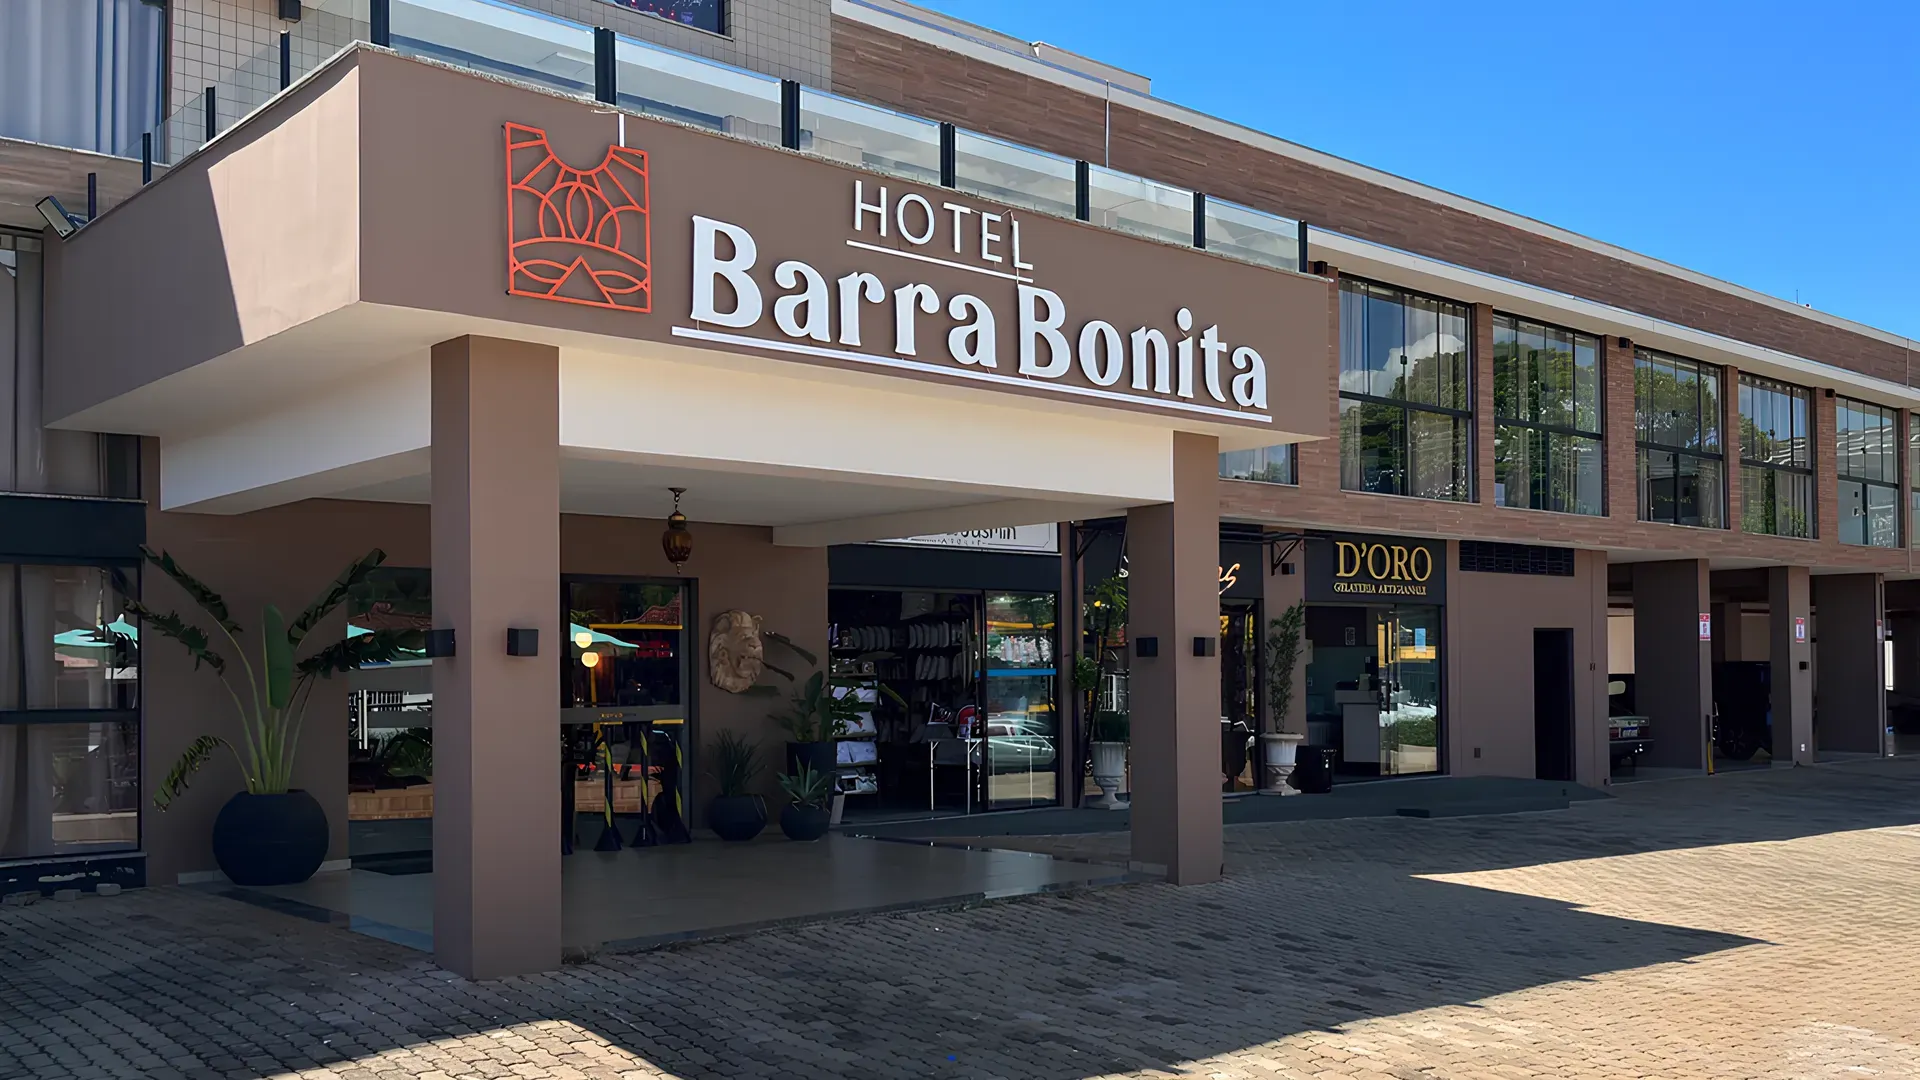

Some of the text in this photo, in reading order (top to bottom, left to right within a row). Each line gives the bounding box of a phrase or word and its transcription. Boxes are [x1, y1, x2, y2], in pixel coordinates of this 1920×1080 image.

[853, 179, 1034, 271] HOTEL
[690, 214, 1268, 410] Barra Bonita
[1335, 541, 1433, 582] D'ORO
